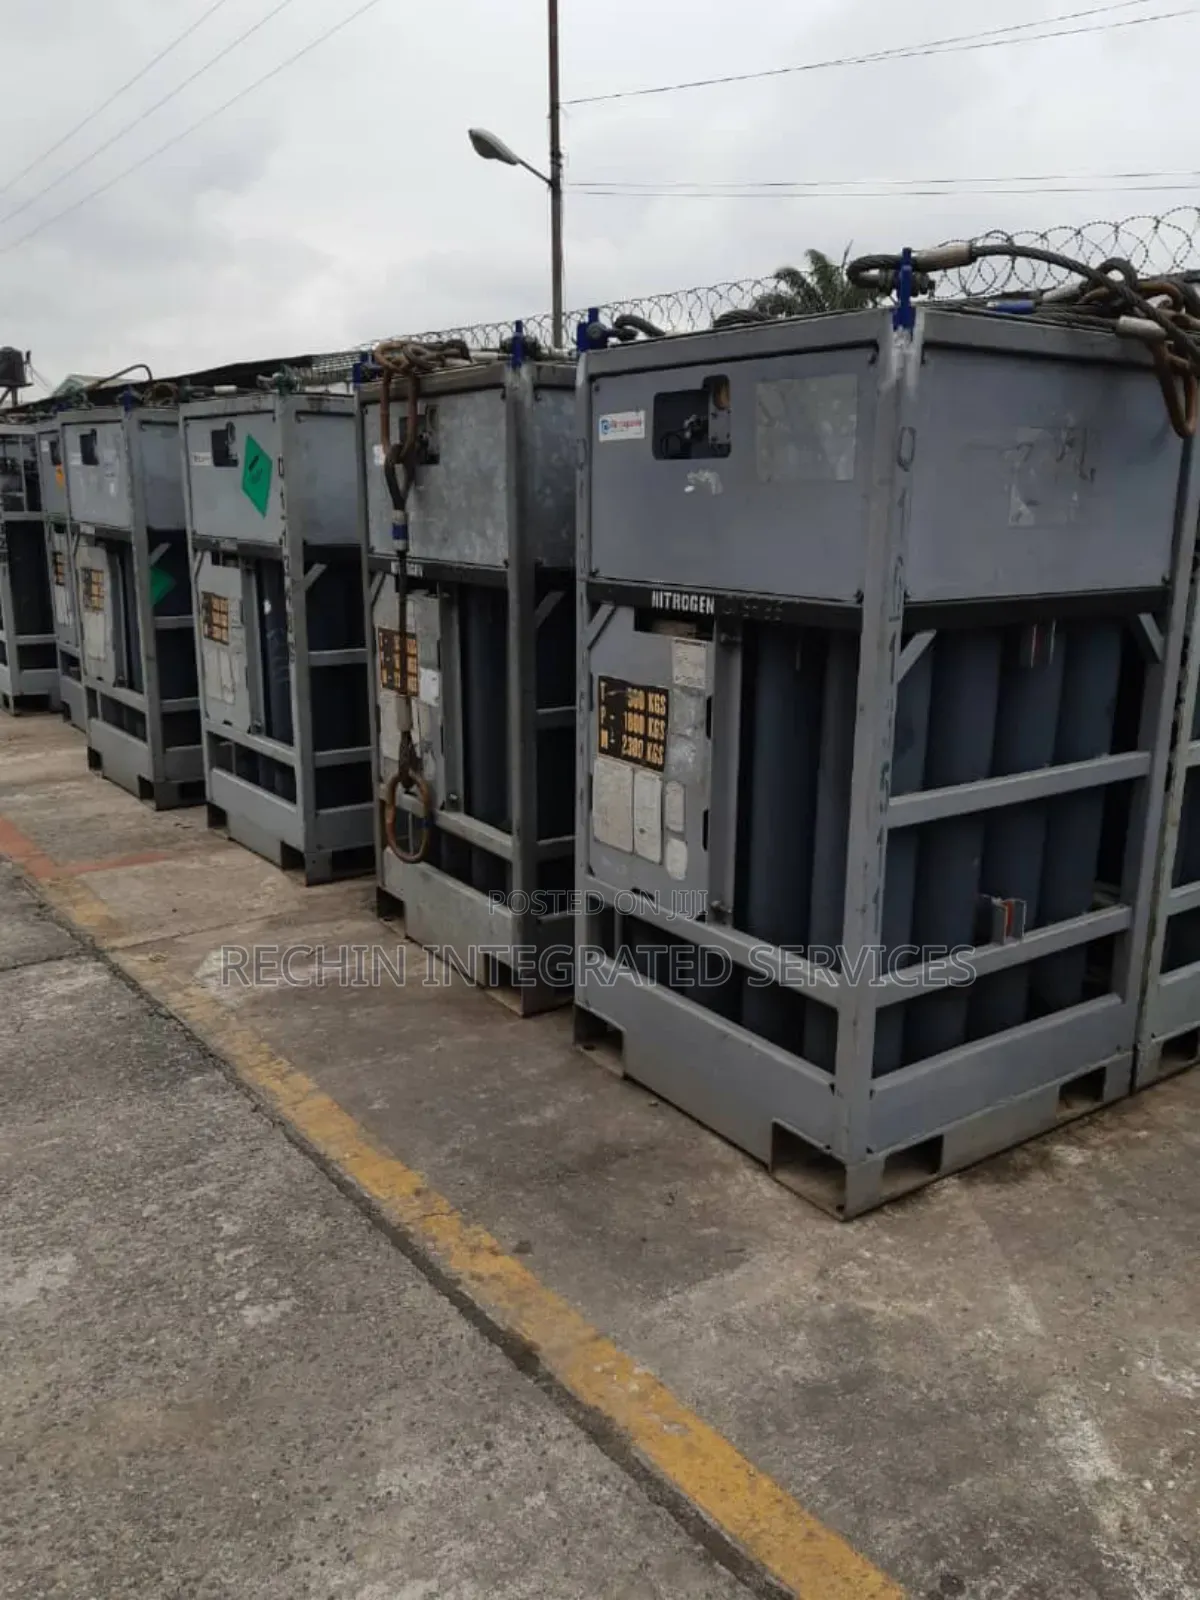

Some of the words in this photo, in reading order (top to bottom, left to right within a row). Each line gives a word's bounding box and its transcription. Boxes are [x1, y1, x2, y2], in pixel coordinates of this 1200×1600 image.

[651, 590, 715, 615] NITROGEN
[648, 692, 666, 716] KGS
[648, 717, 666, 740] KGS
[646, 742, 664, 765] KGS
